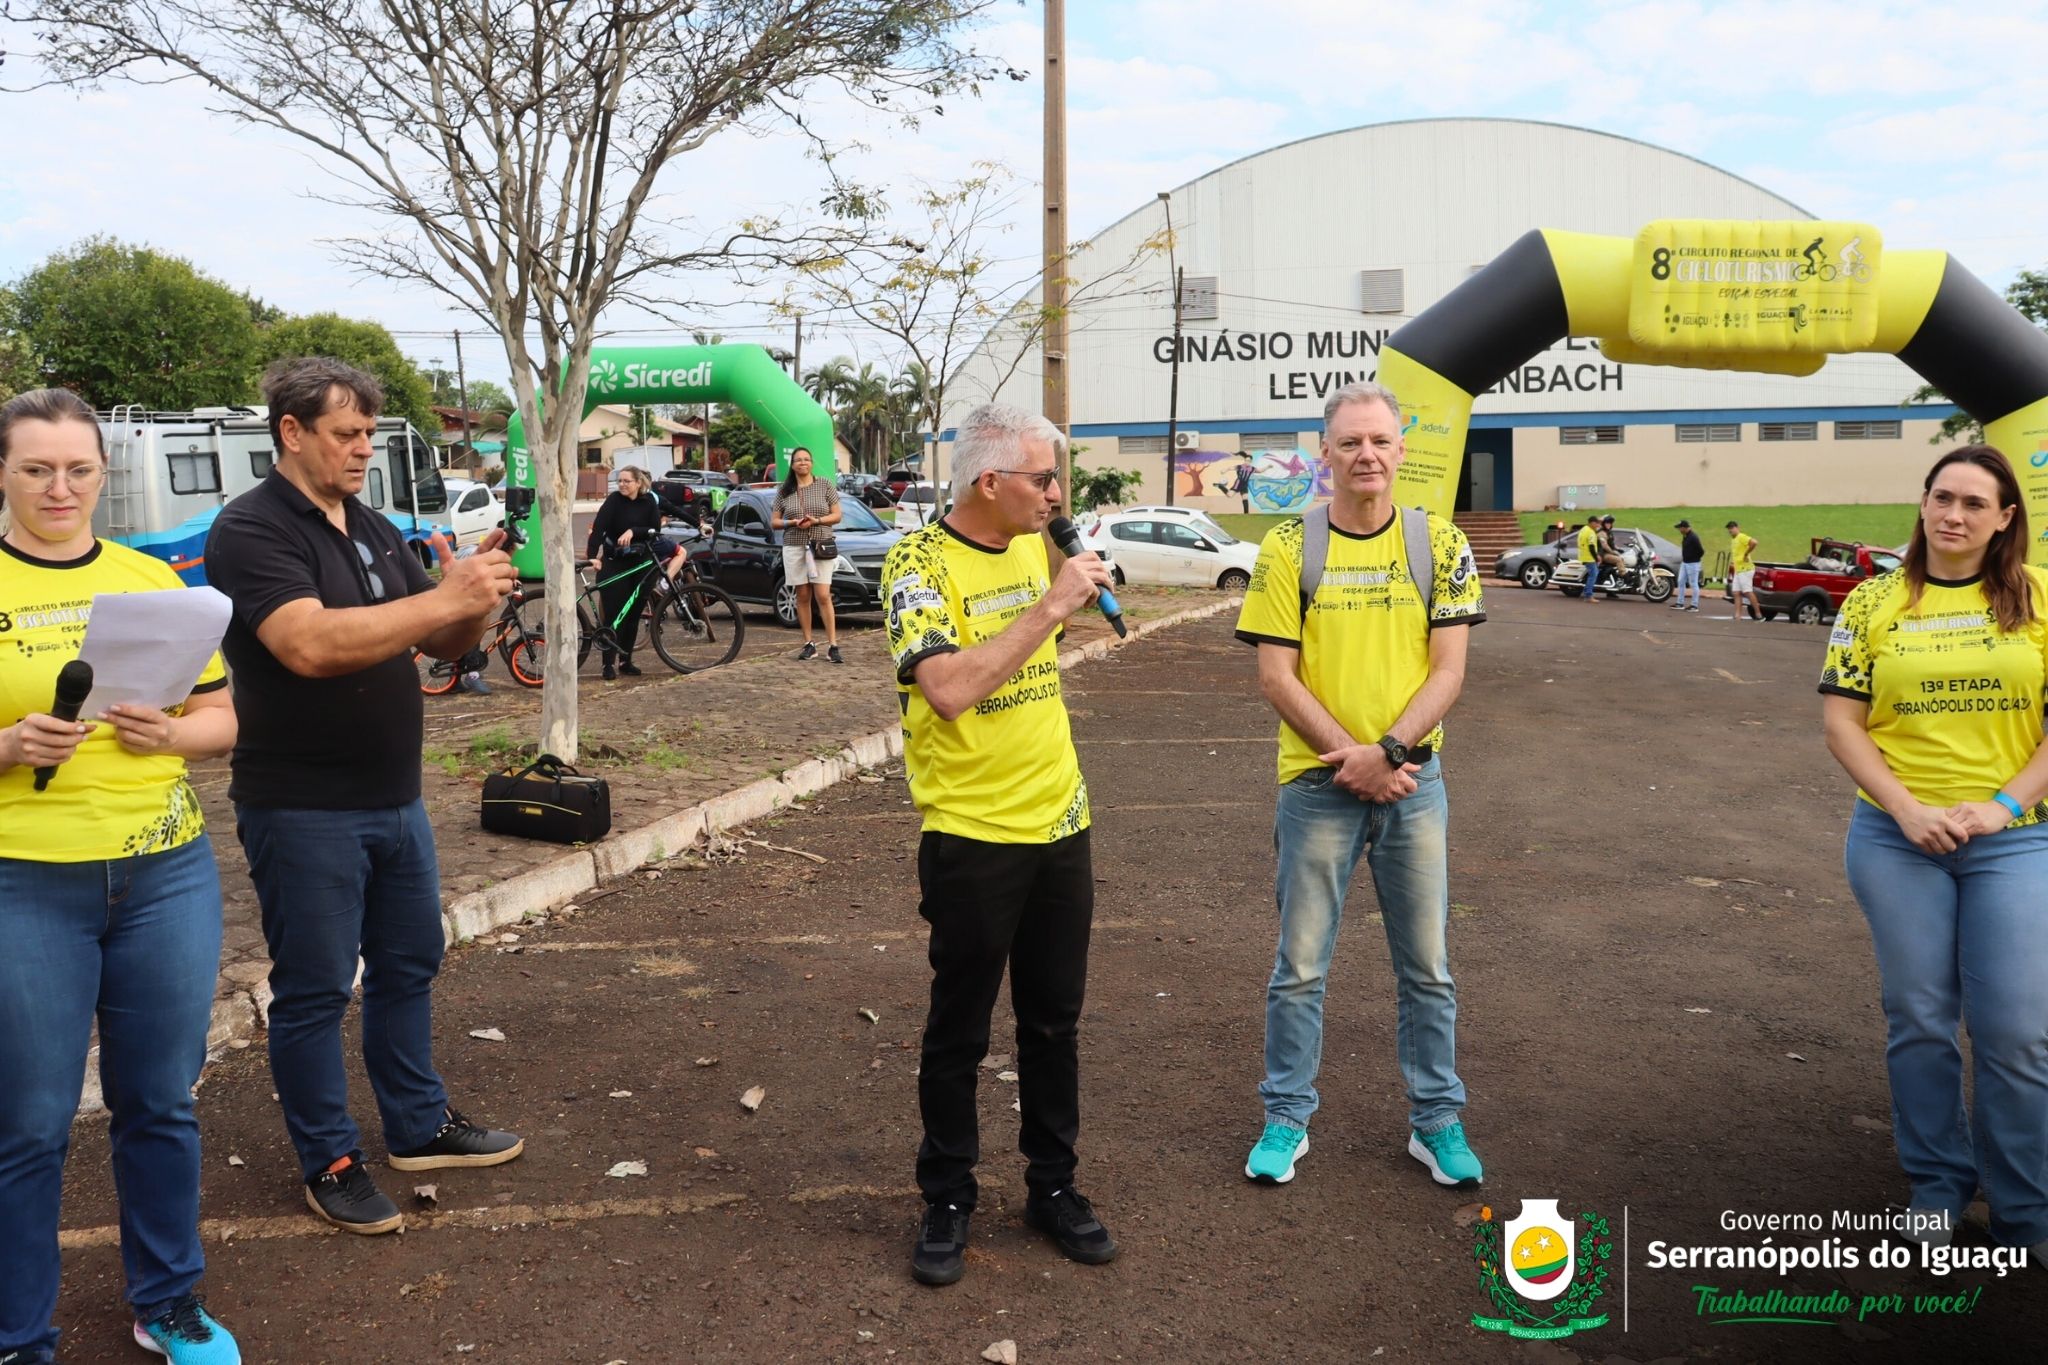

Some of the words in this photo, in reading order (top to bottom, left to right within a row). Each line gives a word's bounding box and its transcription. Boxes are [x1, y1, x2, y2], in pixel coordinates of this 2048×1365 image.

[1679, 247, 1728, 258] CIRCUITO
[1730, 247, 1781, 258] REGIONAL
[1786, 248, 1799, 257] DE
[1153, 328, 1293, 364] GINÁSIO
[623, 360, 713, 390] Sicredi
[1482, 363, 1623, 394] NBACH
[1420, 422, 1450, 435] adetur
[1949, 678, 2002, 692] ETAPA
[1977, 698, 1995, 712] DO
